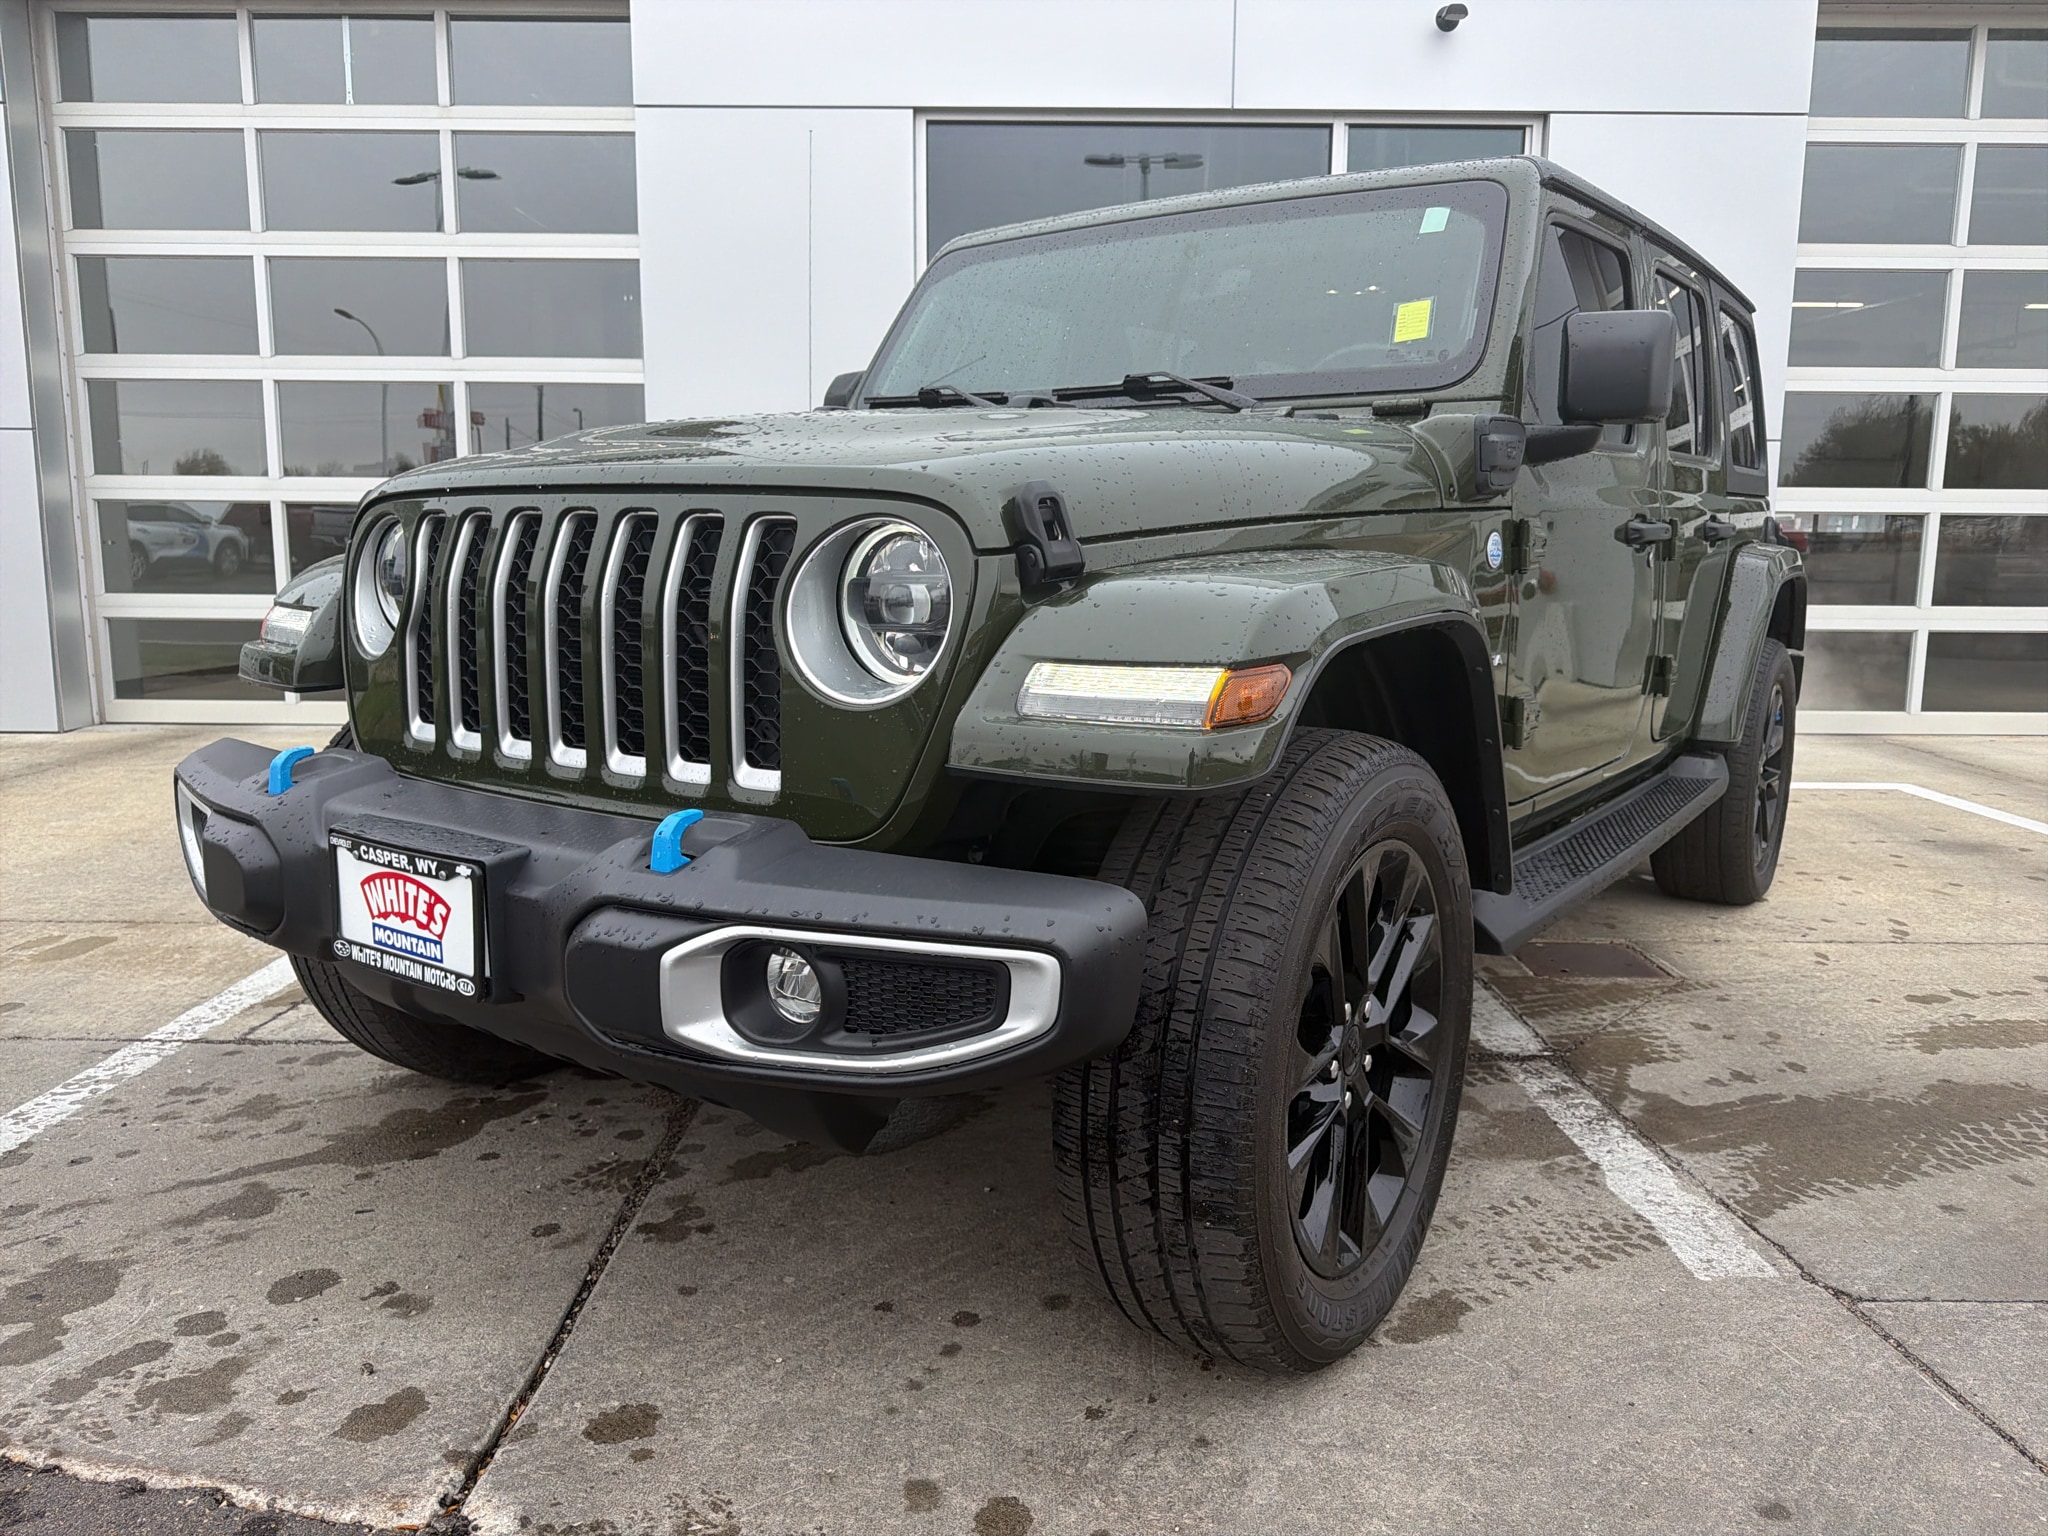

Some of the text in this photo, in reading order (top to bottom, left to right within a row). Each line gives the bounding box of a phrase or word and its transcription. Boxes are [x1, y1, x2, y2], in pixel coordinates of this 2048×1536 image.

[330, 836, 352, 849] CHEVROLET
[360, 845, 438, 876] CASPER, WY
[363, 877, 448, 936] WHITE'S
[374, 926, 442, 960] MOUNTAIN
[351, 943, 456, 991] WHITE'S MOUNTAIN MOTORS
[458, 980, 473, 994] KIA
